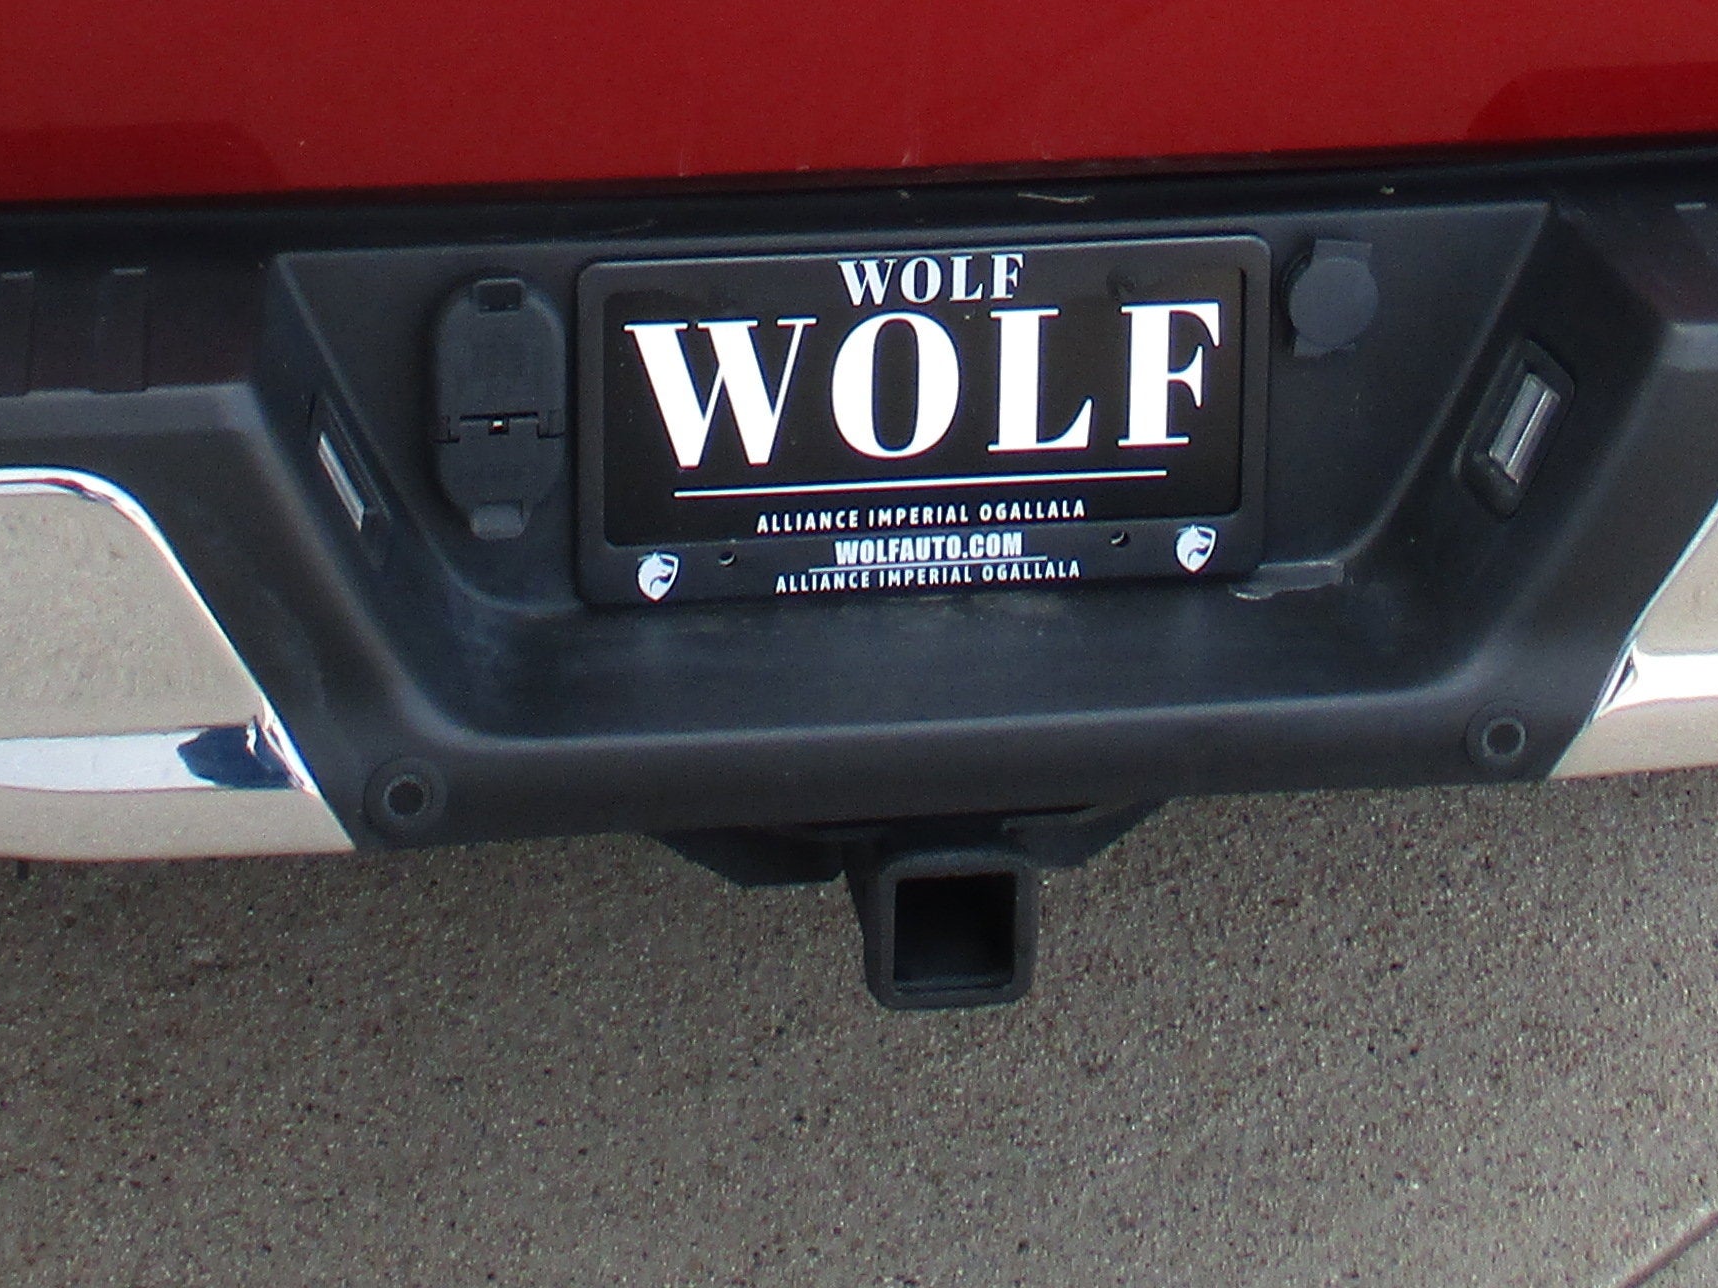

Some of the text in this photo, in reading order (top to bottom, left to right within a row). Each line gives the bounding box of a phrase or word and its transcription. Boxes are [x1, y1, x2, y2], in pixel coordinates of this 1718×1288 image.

[838, 253, 1025, 306] WOLF
[624, 301, 1221, 468] WOLF
[756, 498, 1086, 534] ALLIANCE IMPERIAL OGALLALA
[834, 531, 1023, 566] WOLFAUTO.COM
[774, 559, 1081, 595] ALLIANCE IMPERIAL OGALLALA
